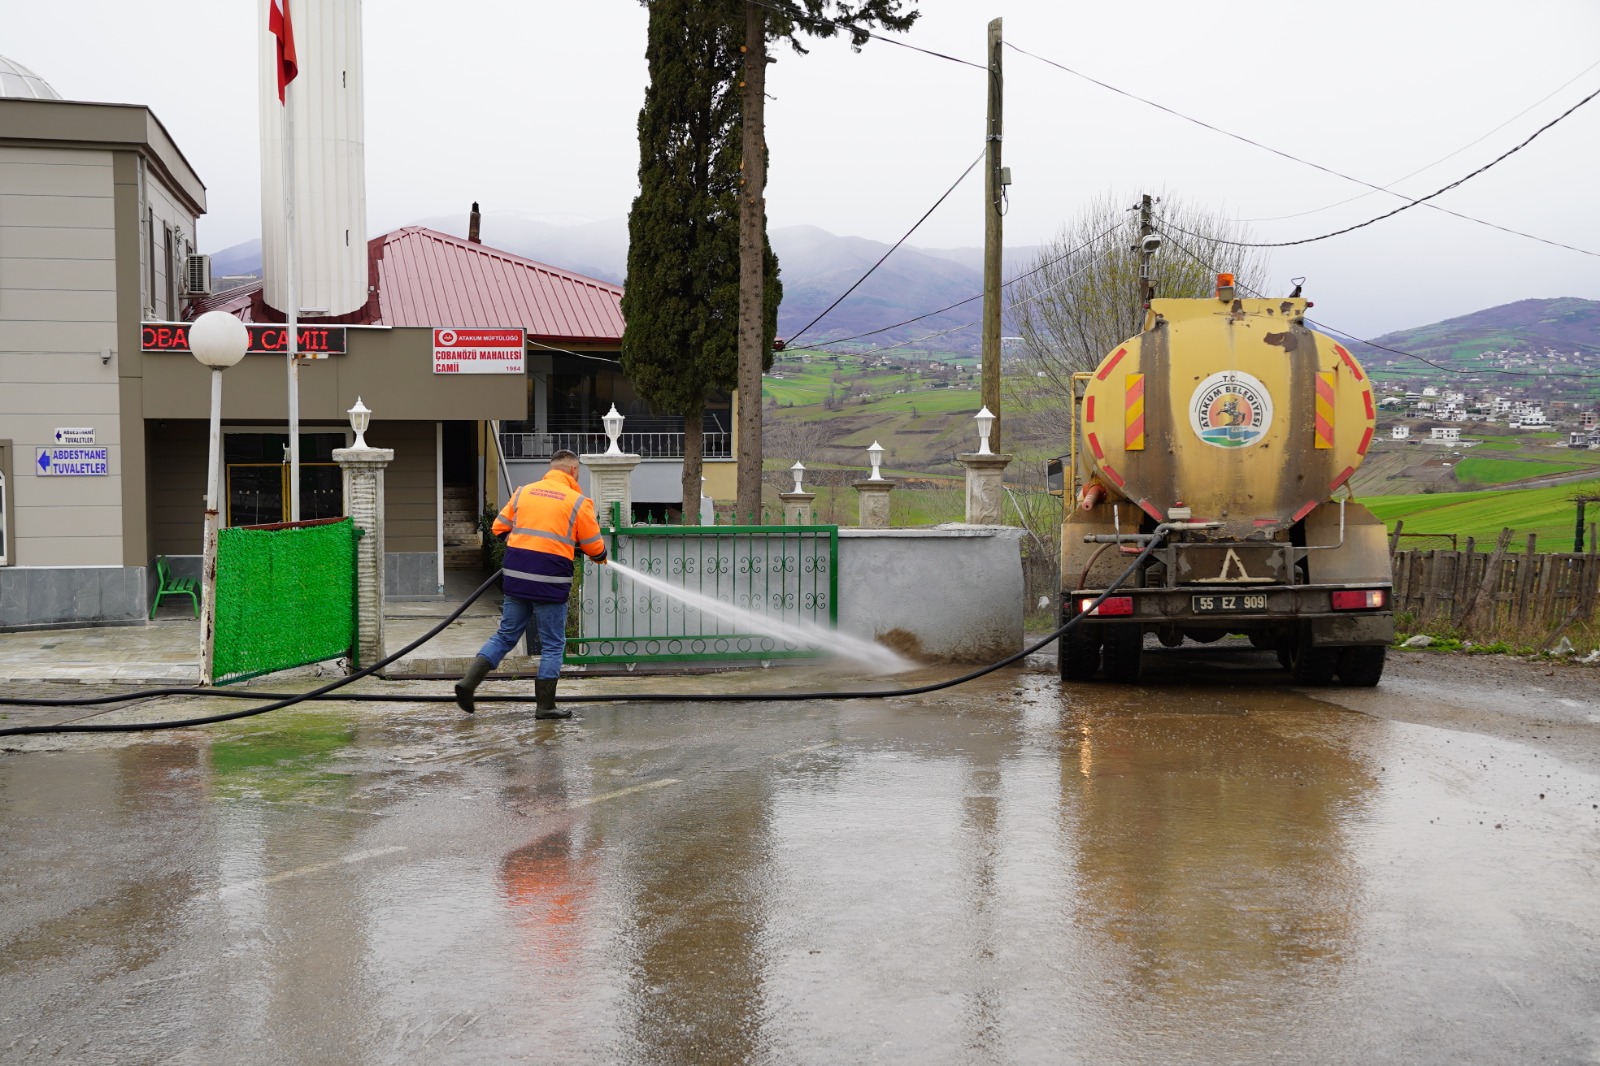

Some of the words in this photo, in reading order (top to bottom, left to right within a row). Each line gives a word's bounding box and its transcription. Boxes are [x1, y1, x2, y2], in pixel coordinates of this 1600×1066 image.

[435, 349, 477, 361] ÇOBANÖZÜ
[436, 362, 459, 372] CAMİİ
[1201, 389, 1222, 428] ATAKUM
[53, 450, 106, 460] ABDESTHANE
[53, 463, 106, 473] TUVALETLER
[1200, 597, 1214, 610] 55
[1222, 596, 1236, 609] EZ
[1244, 596, 1264, 609] 909
